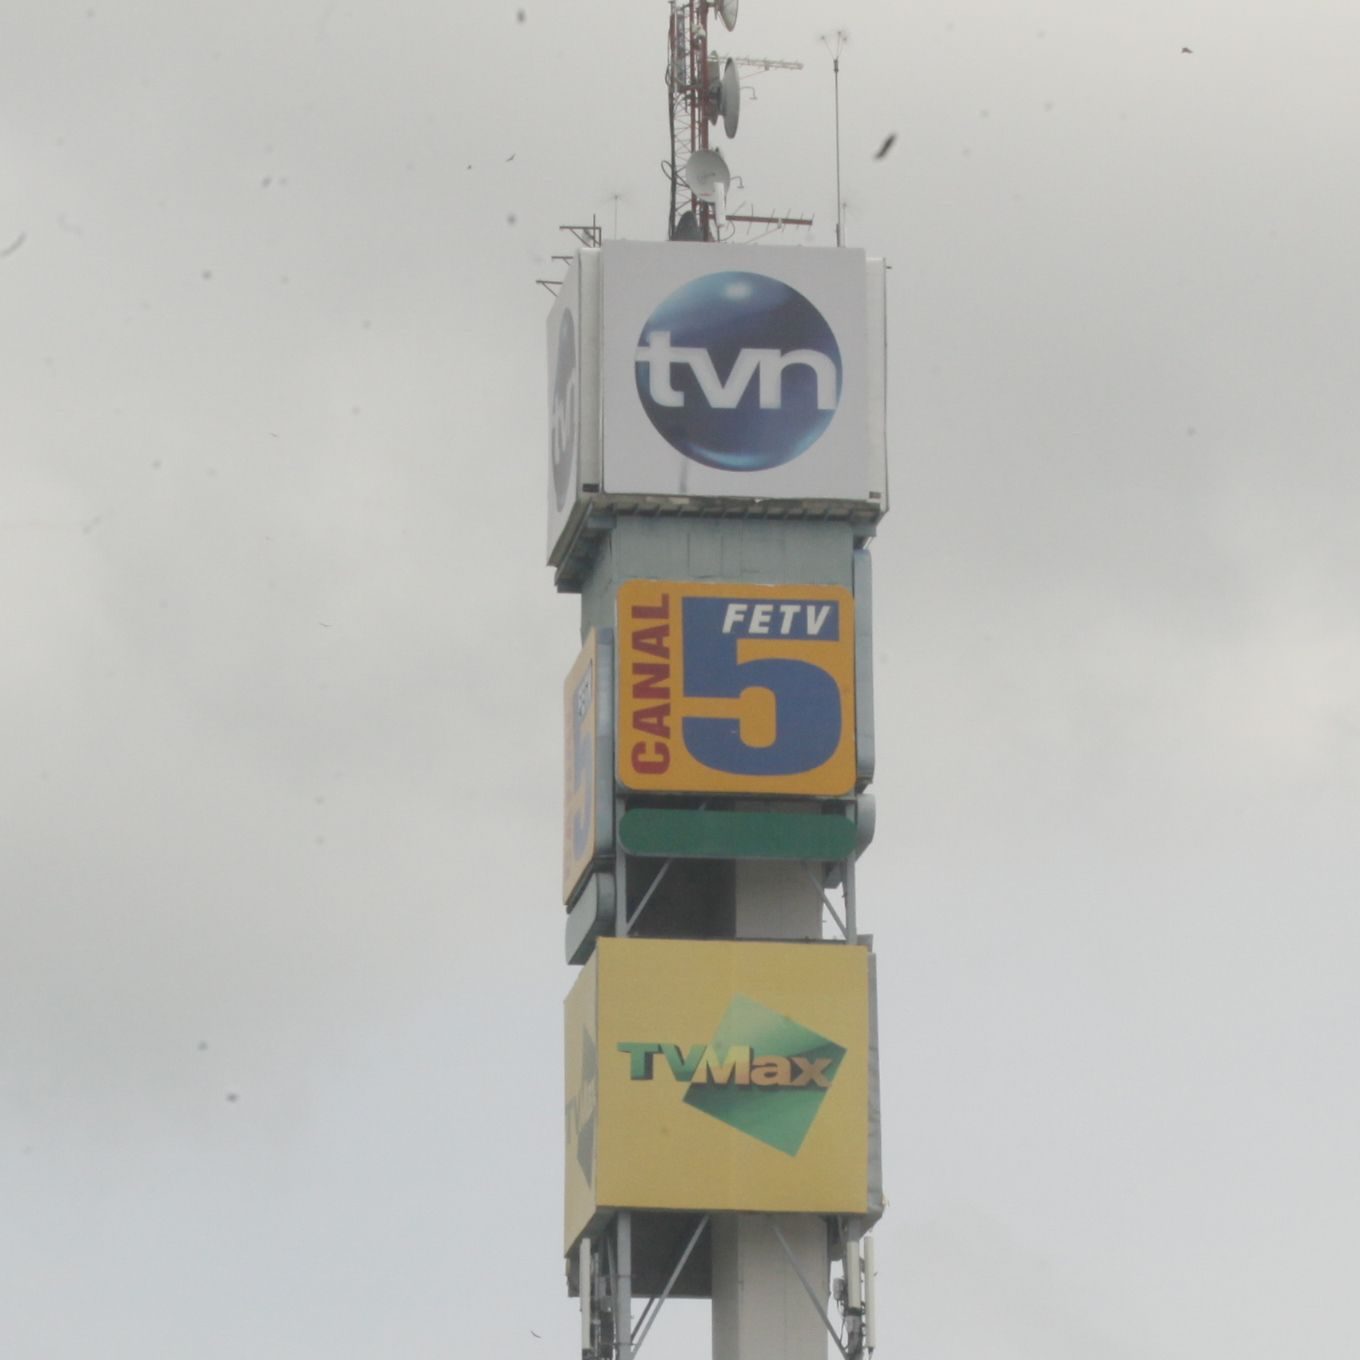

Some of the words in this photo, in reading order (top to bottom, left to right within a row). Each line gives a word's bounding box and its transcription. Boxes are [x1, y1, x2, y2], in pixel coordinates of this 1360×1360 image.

[635, 331, 838, 410] tvn
[721, 603, 831, 636] FETV
[631, 593, 671, 775] CANAL
[681, 596, 842, 776] 5
[617, 1042, 833, 1088] TVMax
